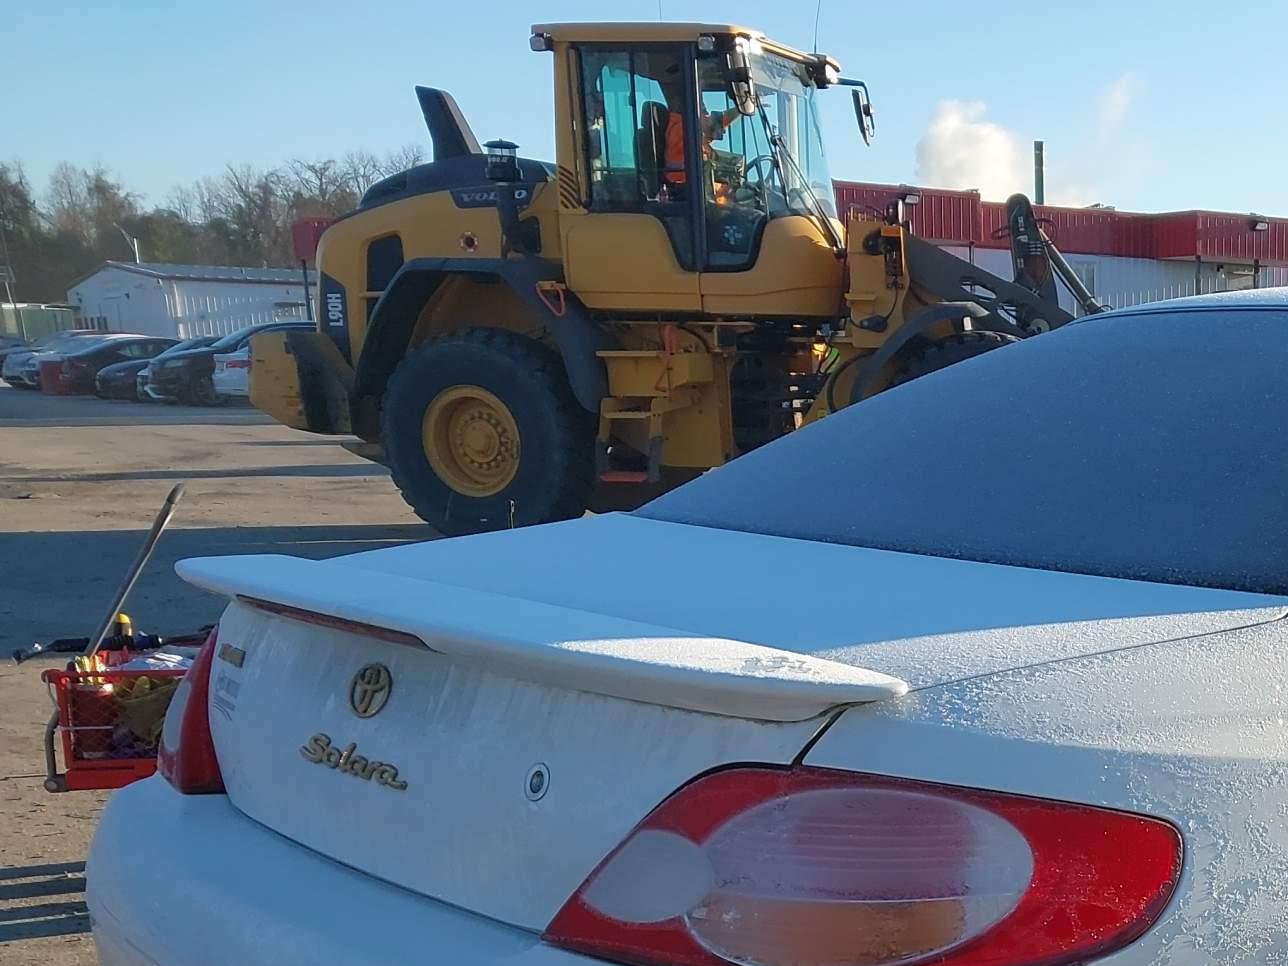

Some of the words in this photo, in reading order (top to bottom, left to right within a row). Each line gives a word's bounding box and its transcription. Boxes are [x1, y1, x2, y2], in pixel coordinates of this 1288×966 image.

[461, 190, 528, 203] VOLO
[326, 292, 344, 327] L90H
[299, 732, 408, 790] Solara
